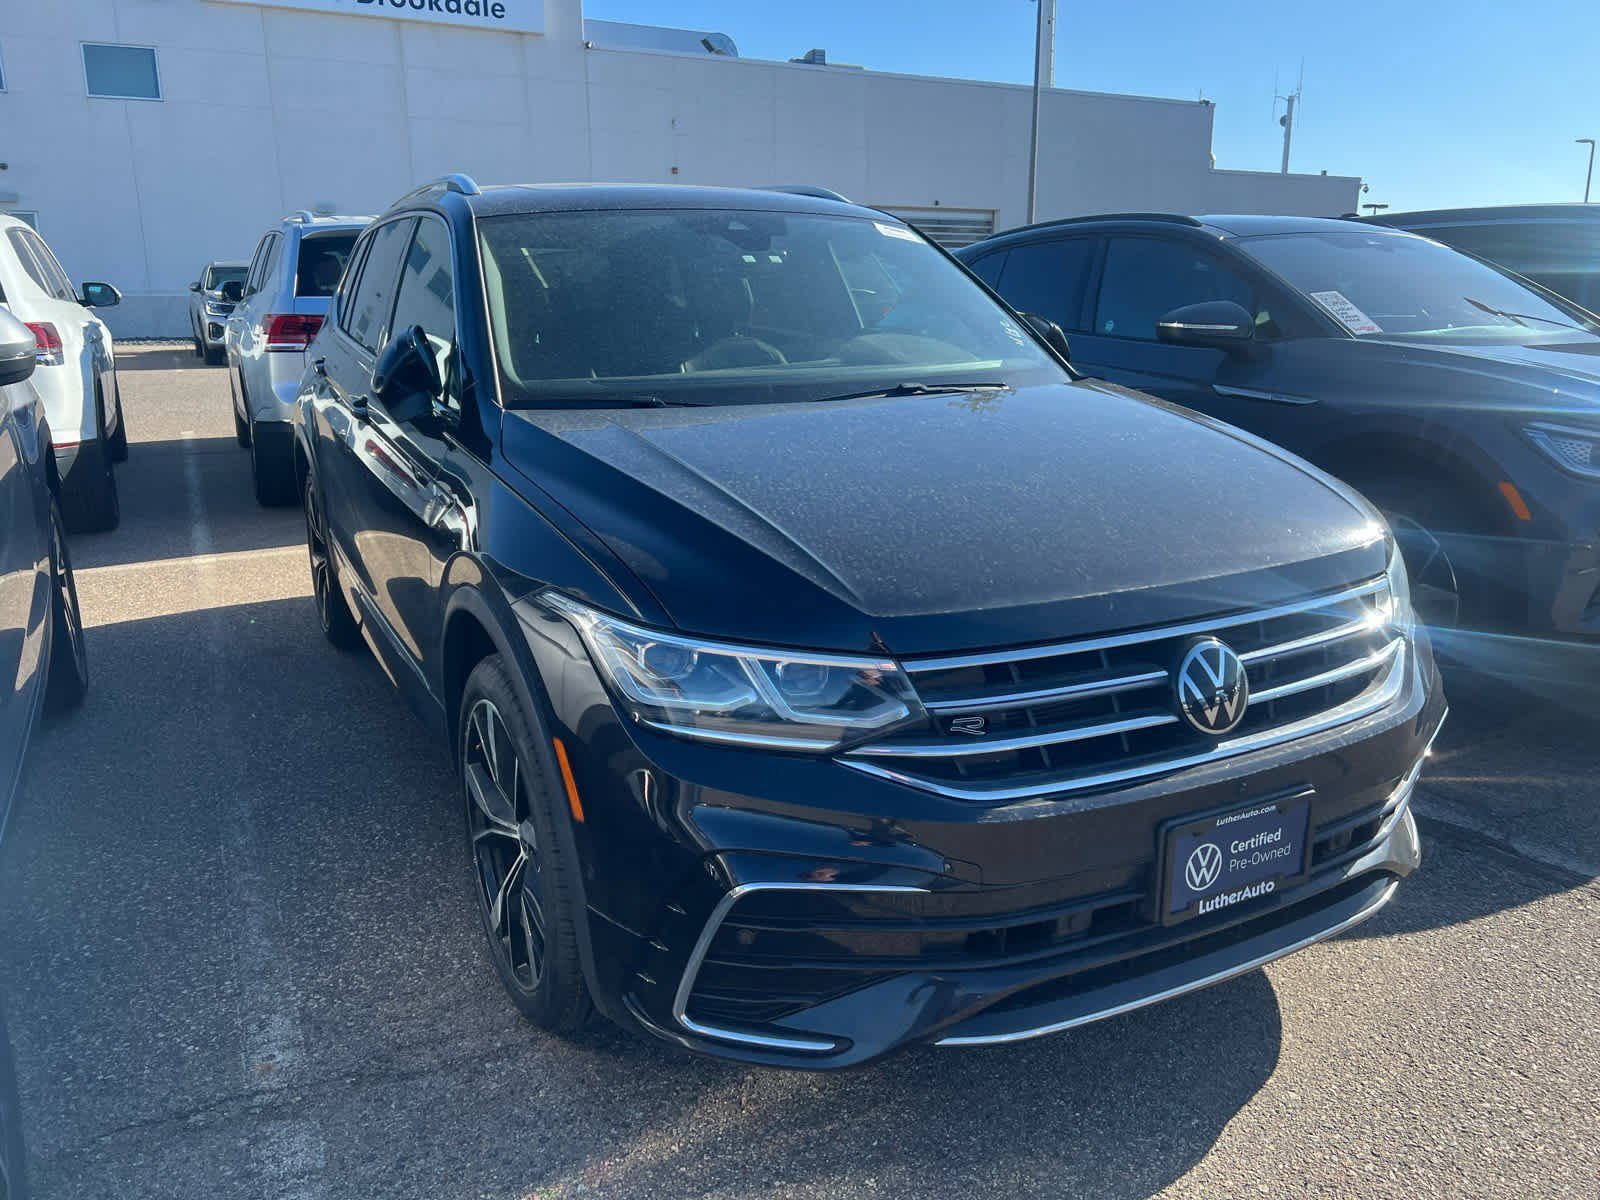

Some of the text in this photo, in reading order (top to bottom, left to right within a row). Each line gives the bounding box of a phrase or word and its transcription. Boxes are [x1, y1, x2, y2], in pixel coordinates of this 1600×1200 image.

[1216, 805, 1276, 826] LutherAuto.com
[1230, 828, 1282, 854] Certified
[1187, 845, 1222, 889] VW
[1229, 843, 1291, 872] Pre-Owned
[1199, 880, 1275, 915] LutherAuto
